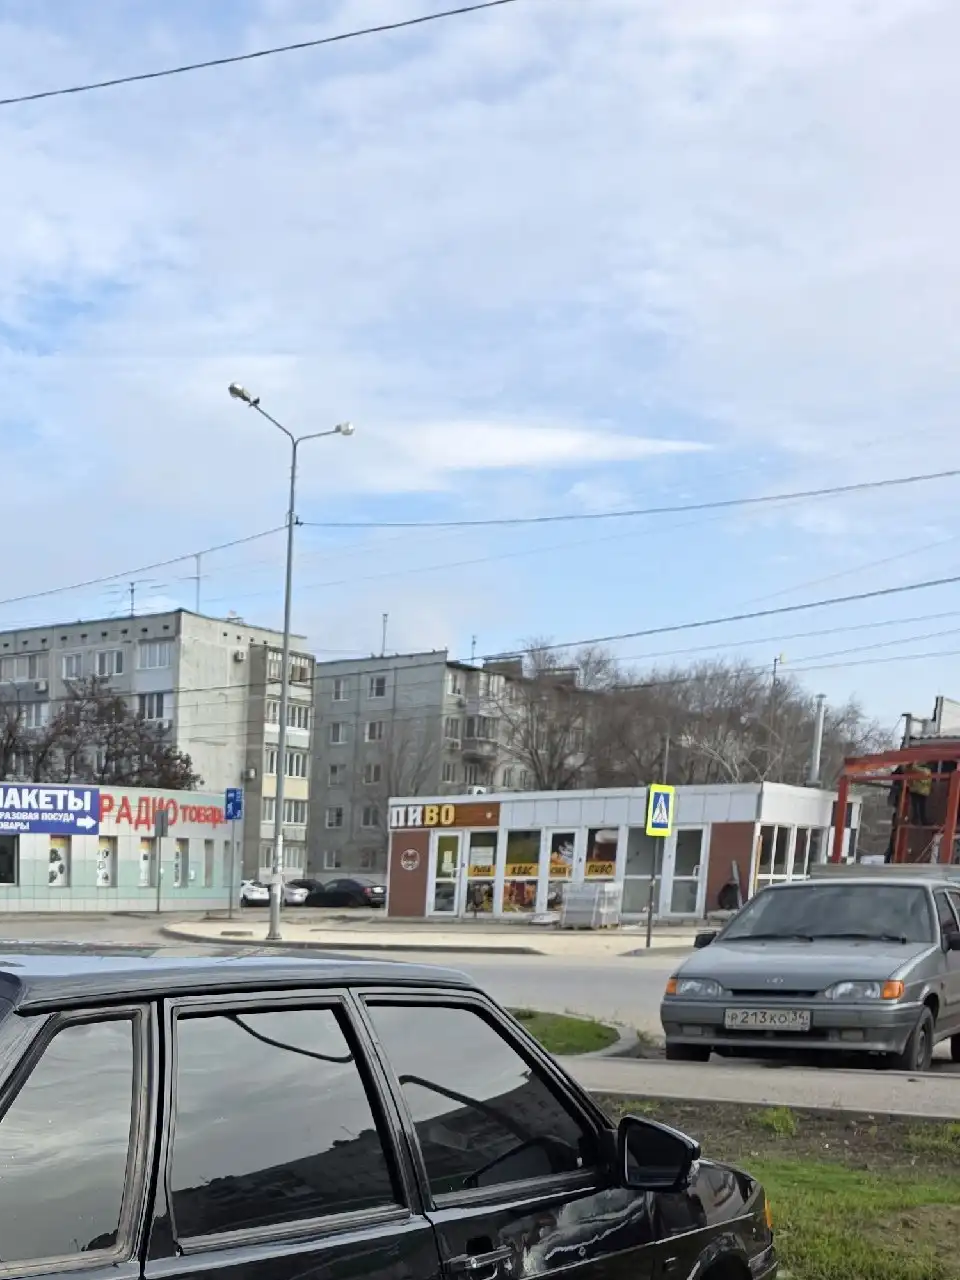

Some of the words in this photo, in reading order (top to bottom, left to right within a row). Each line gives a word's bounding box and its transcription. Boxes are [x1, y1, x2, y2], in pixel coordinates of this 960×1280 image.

[41, 812, 74, 822] ПОСУДА
[98, 793, 178, 831] РАДИО
[391, 804, 455, 827] ПИВО
